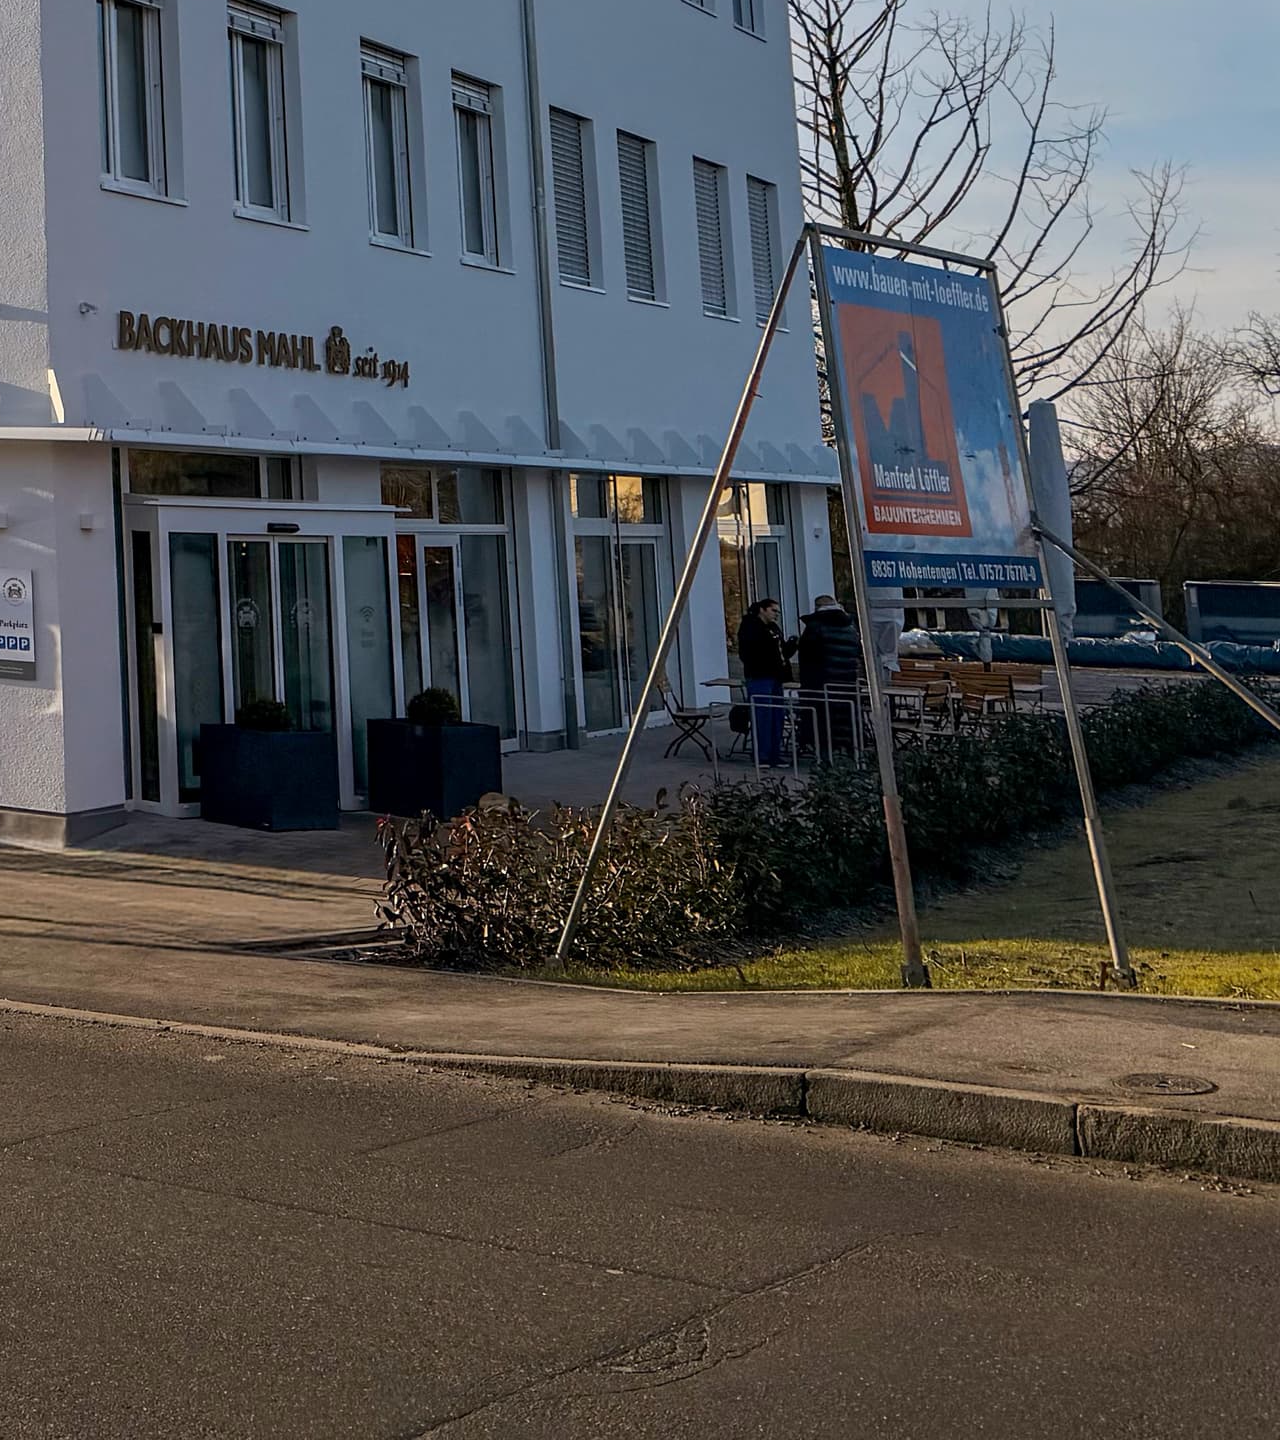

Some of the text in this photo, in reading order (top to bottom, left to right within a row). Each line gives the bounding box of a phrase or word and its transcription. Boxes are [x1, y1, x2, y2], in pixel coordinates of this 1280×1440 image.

[833, 265, 989, 312] www.bauen-mit-loeffler.de
[119, 310, 409, 388] BACKHAUS MAHL seit 1914
[873, 463, 951, 493] Manfred Löffler
[873, 505, 962, 527] BAUUNTERNEHMEN
[871, 560, 897, 578] 88367
[898, 560, 958, 583] Hohentengen
[962, 563, 980, 580] Tel.
[978, 564, 1006, 581] 07572
